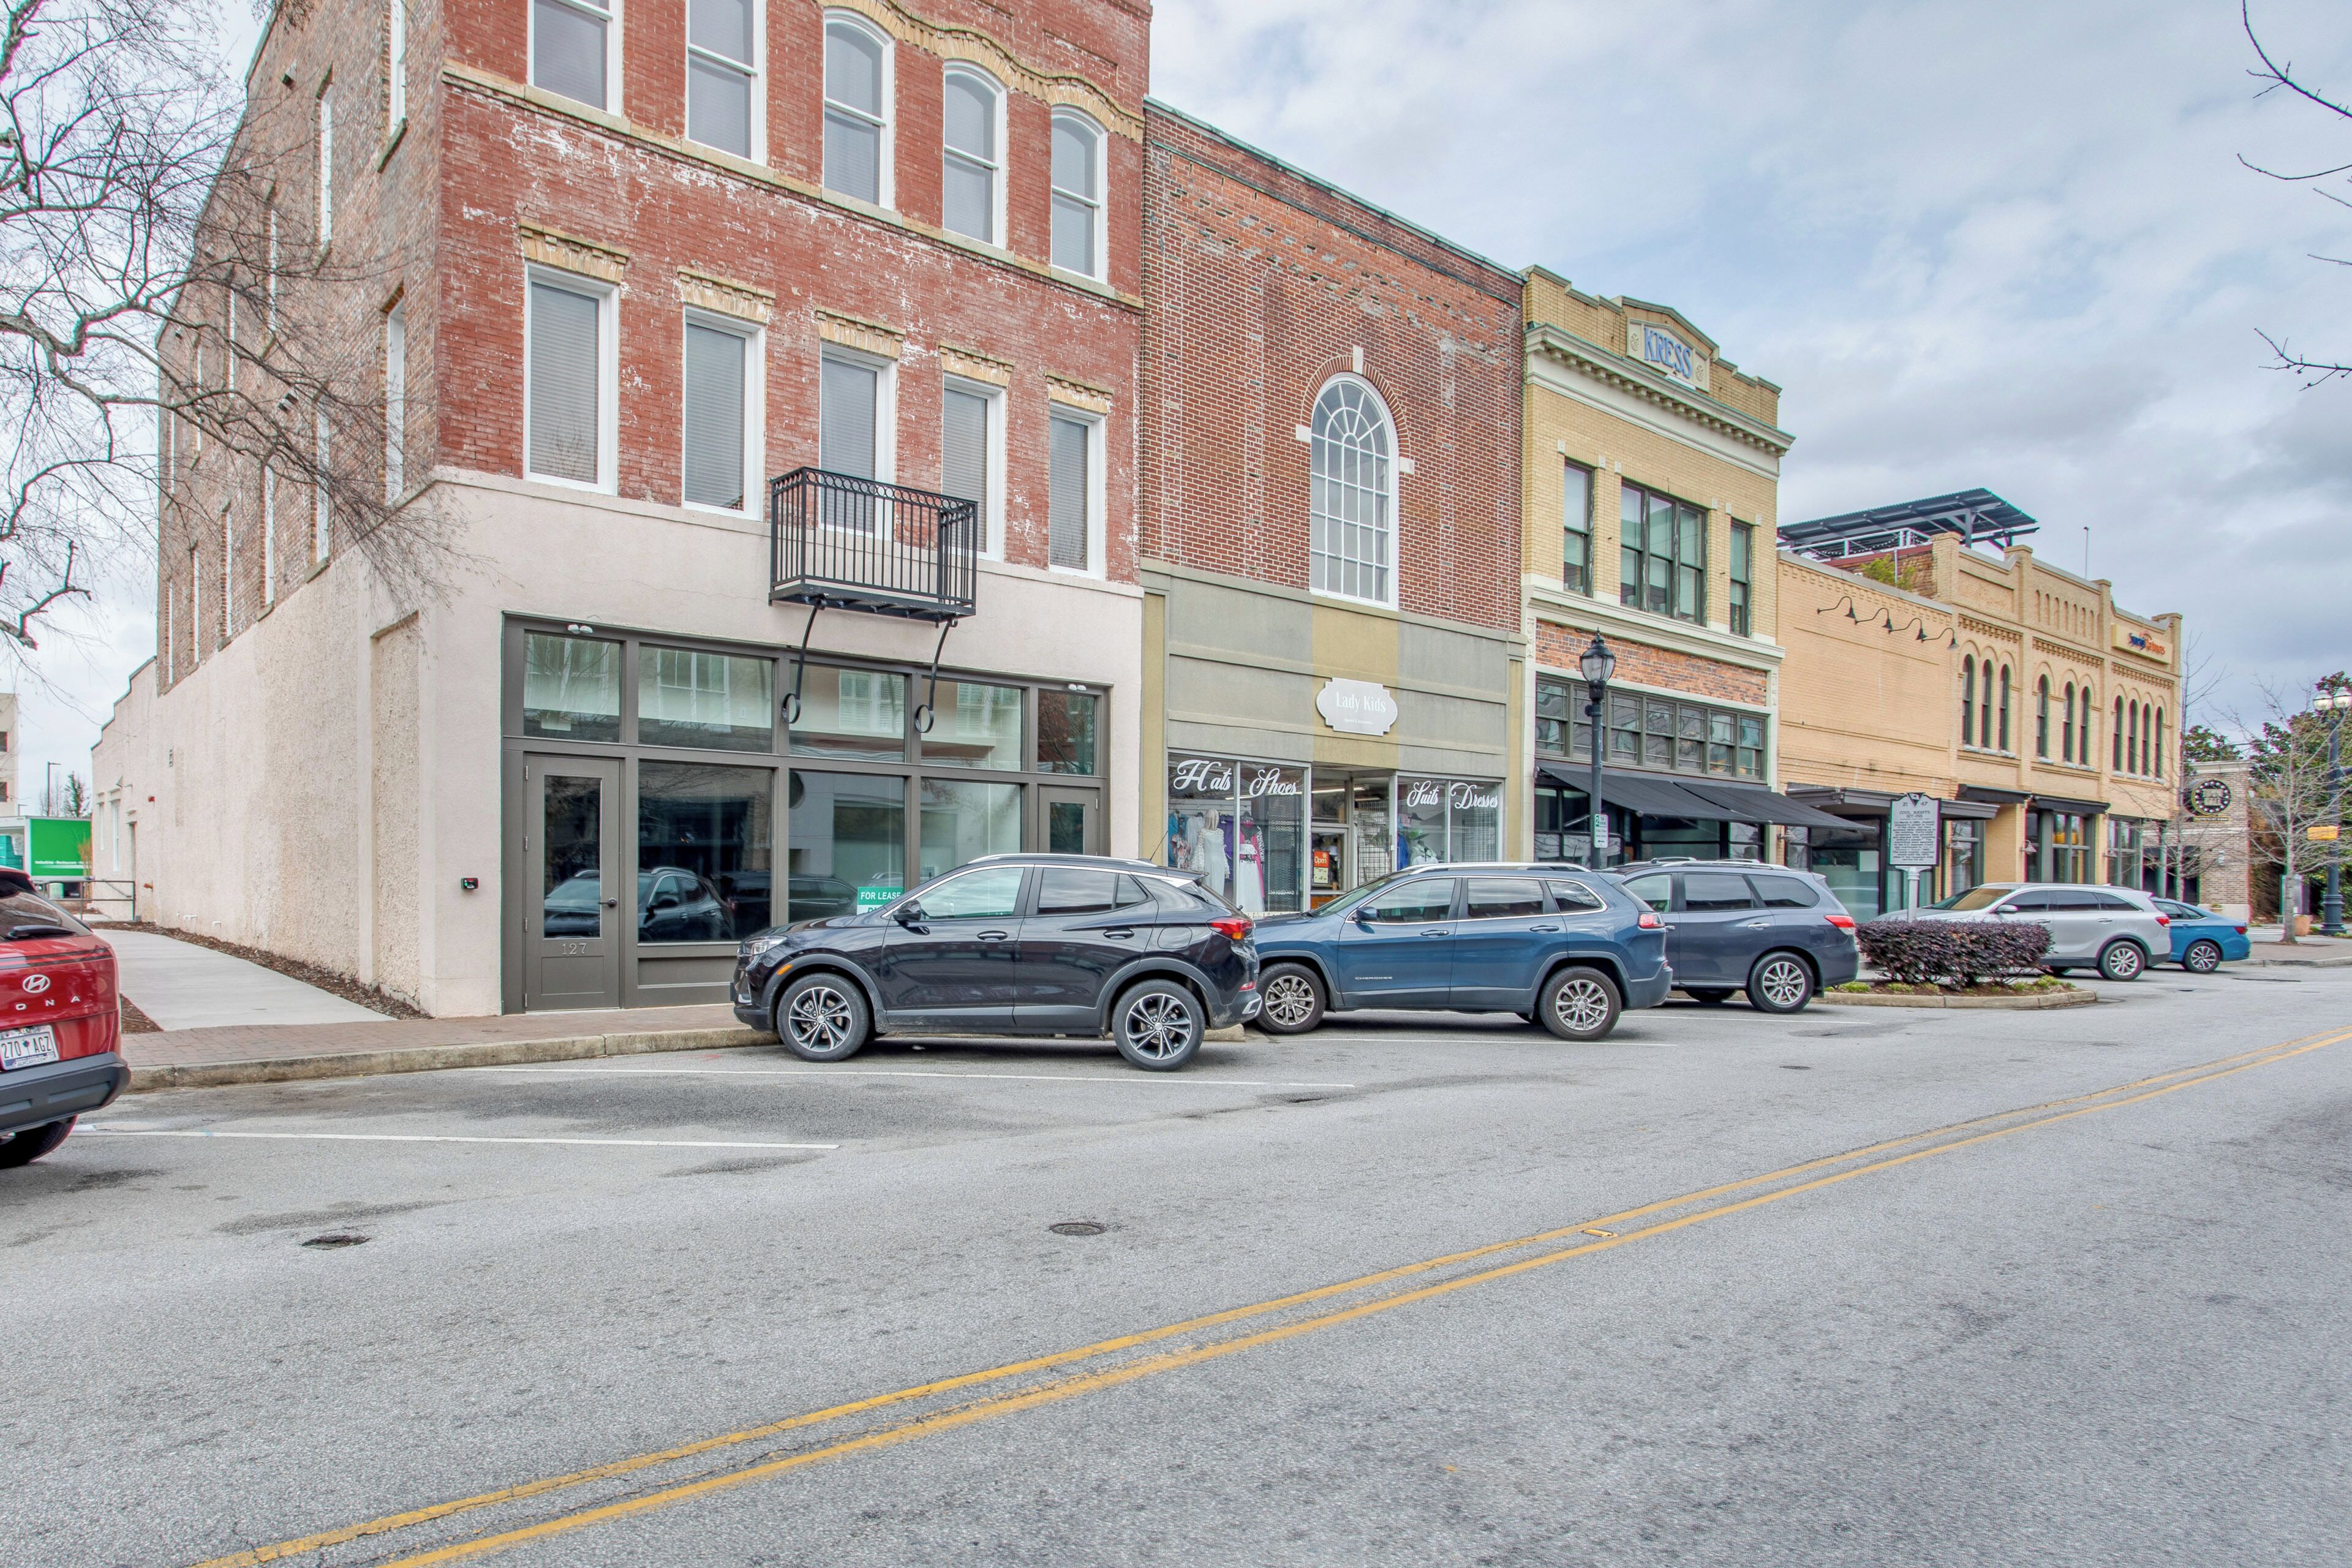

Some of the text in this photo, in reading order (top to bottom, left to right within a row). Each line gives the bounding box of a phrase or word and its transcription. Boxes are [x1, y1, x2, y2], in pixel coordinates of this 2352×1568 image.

[1644, 327, 1692, 379] KRESS
[1336, 692, 1386, 712] Lady Kids
[1174, 760, 1297, 796] Hats Shoes
[1407, 780, 1498, 809] Suits Dresses
[1314, 856, 1327, 865] Open
[562, 943, 587, 955] 127
[1, 1041, 21, 1058] 270
[33, 1036, 52, 1053] AGZ
